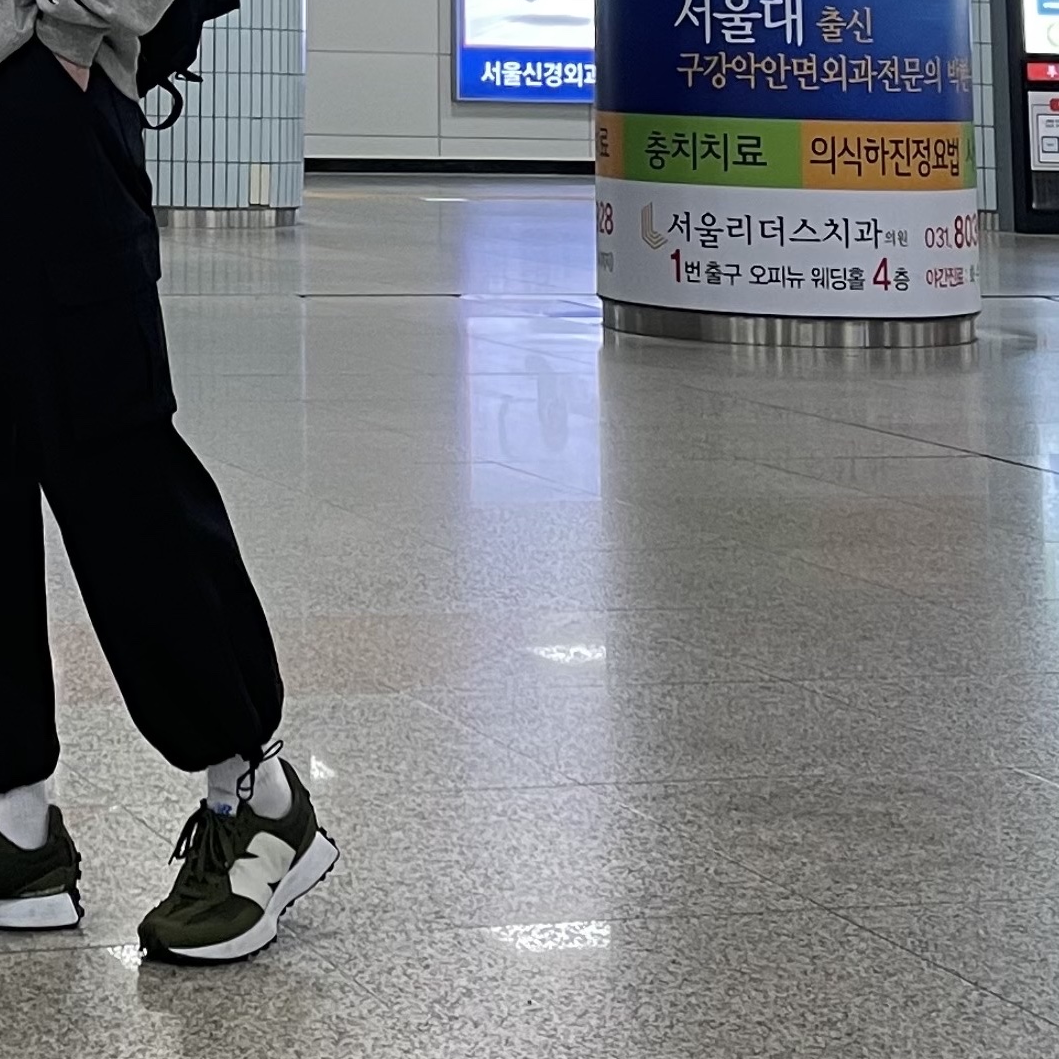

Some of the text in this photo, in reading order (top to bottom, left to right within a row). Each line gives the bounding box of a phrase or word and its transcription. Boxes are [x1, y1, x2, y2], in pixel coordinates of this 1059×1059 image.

[816, 6, 874, 43] 출신
[676, 52, 942, 94] 구강악안면외과전문의
[644, 130, 768, 172] 충치치료
[809, 135, 960, 178] 의식하진정요법
[748, 264, 806, 290] 오피뉴
[811, 266, 866, 291] 웨딩홀
[872, 257, 911, 292] 4층
